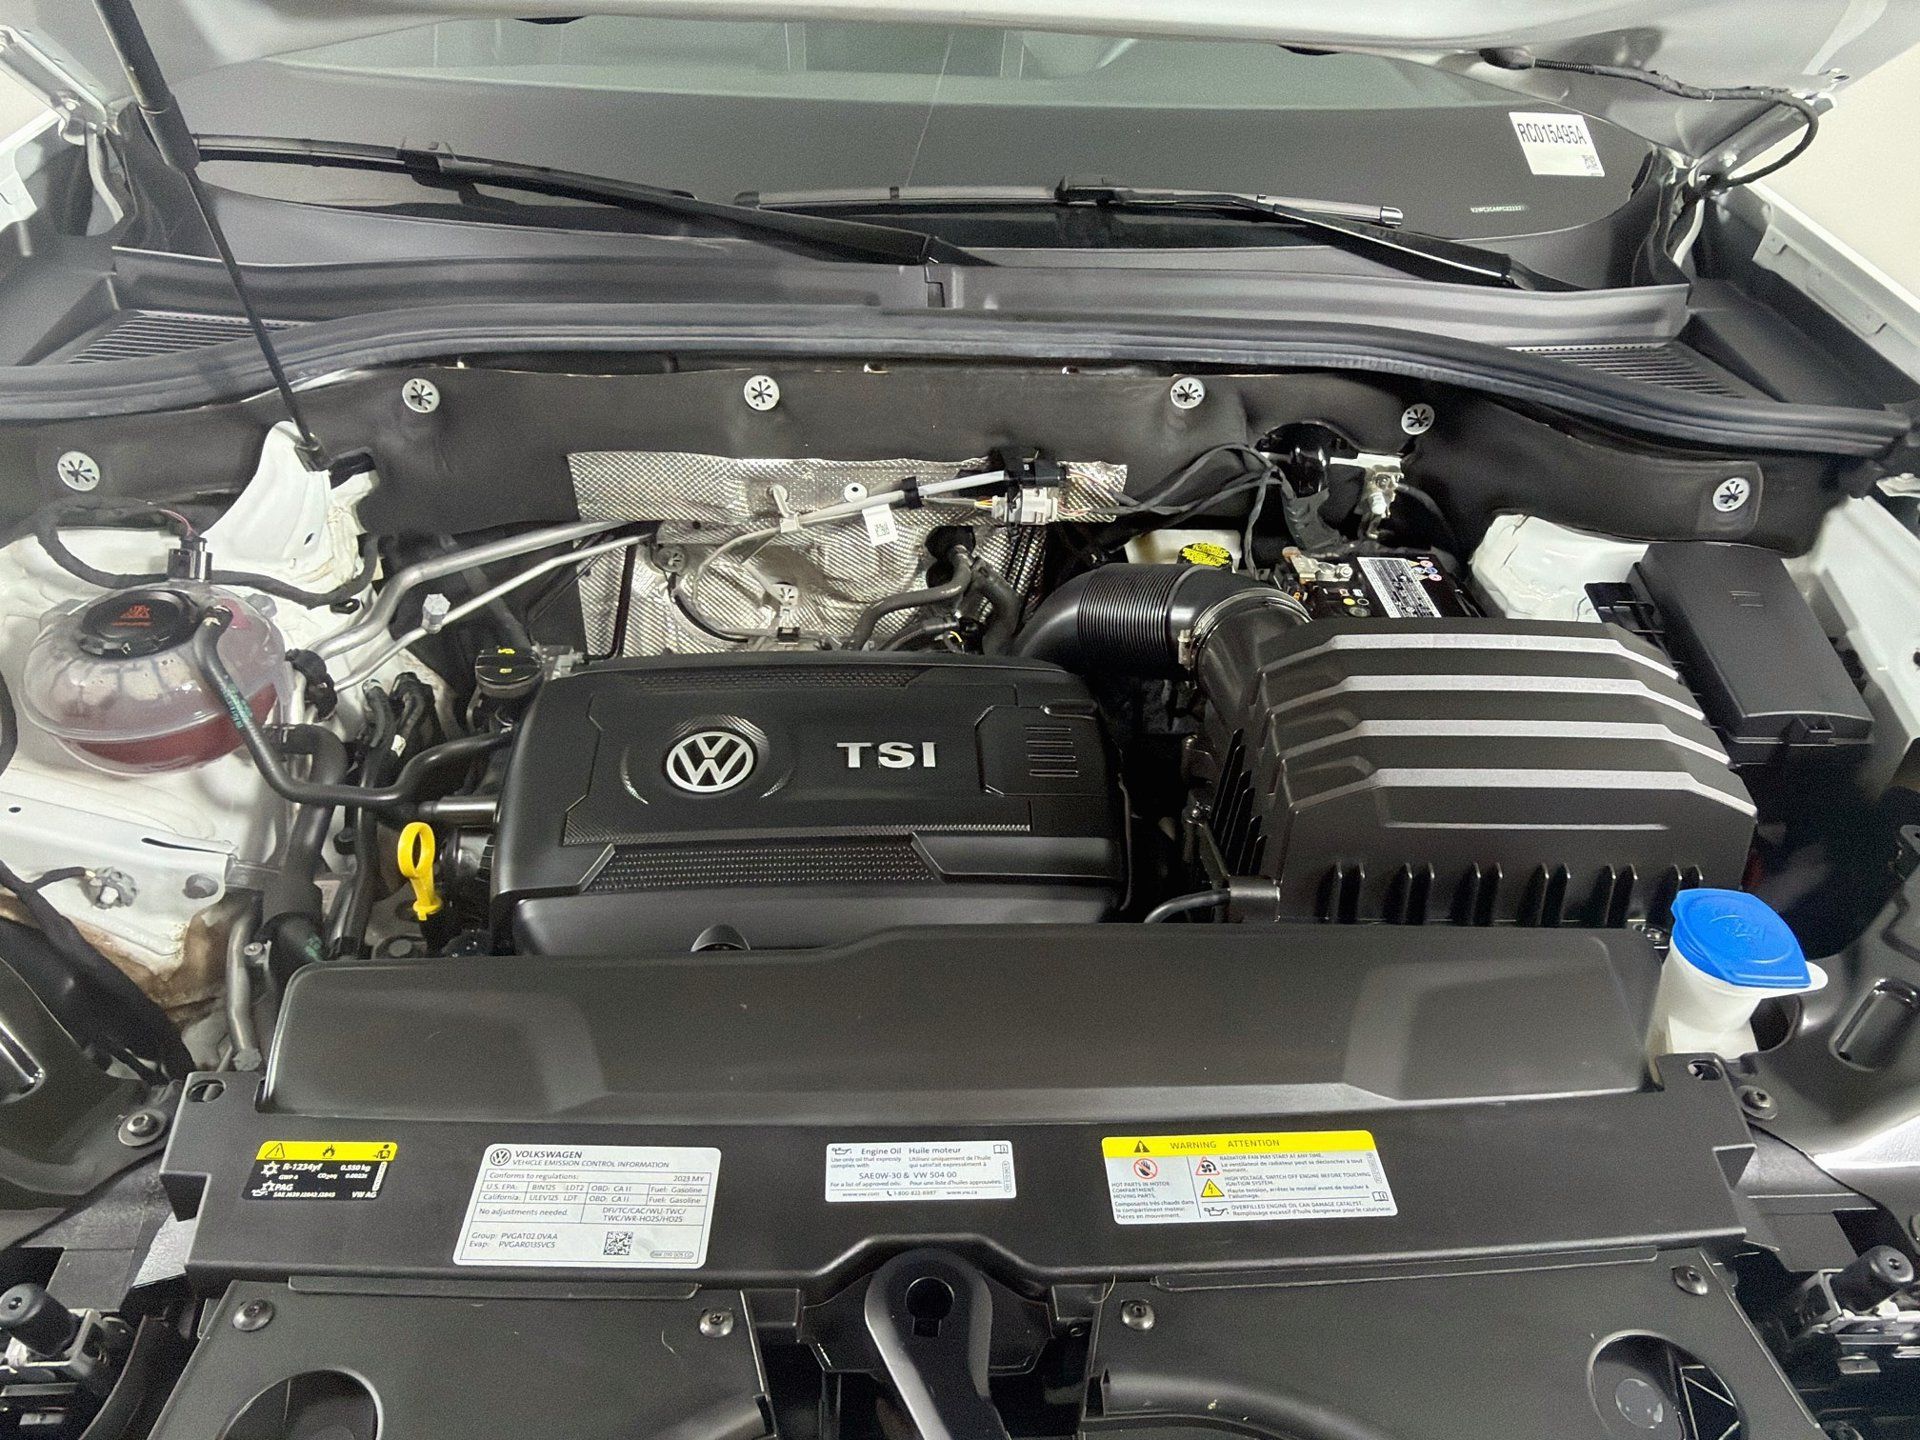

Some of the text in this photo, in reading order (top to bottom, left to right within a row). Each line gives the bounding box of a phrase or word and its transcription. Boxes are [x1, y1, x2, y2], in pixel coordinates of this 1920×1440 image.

[1517, 123, 1587, 144] RC015495A
[836, 742, 936, 768] TSI
[1170, 1140, 1280, 1150] WARNING ATTENTION
[516, 1150, 582, 1158] VOLKSWAGEN
[862, 1148, 888, 1156] Engine
[282, 1163, 322, 1172] R-1234yf
